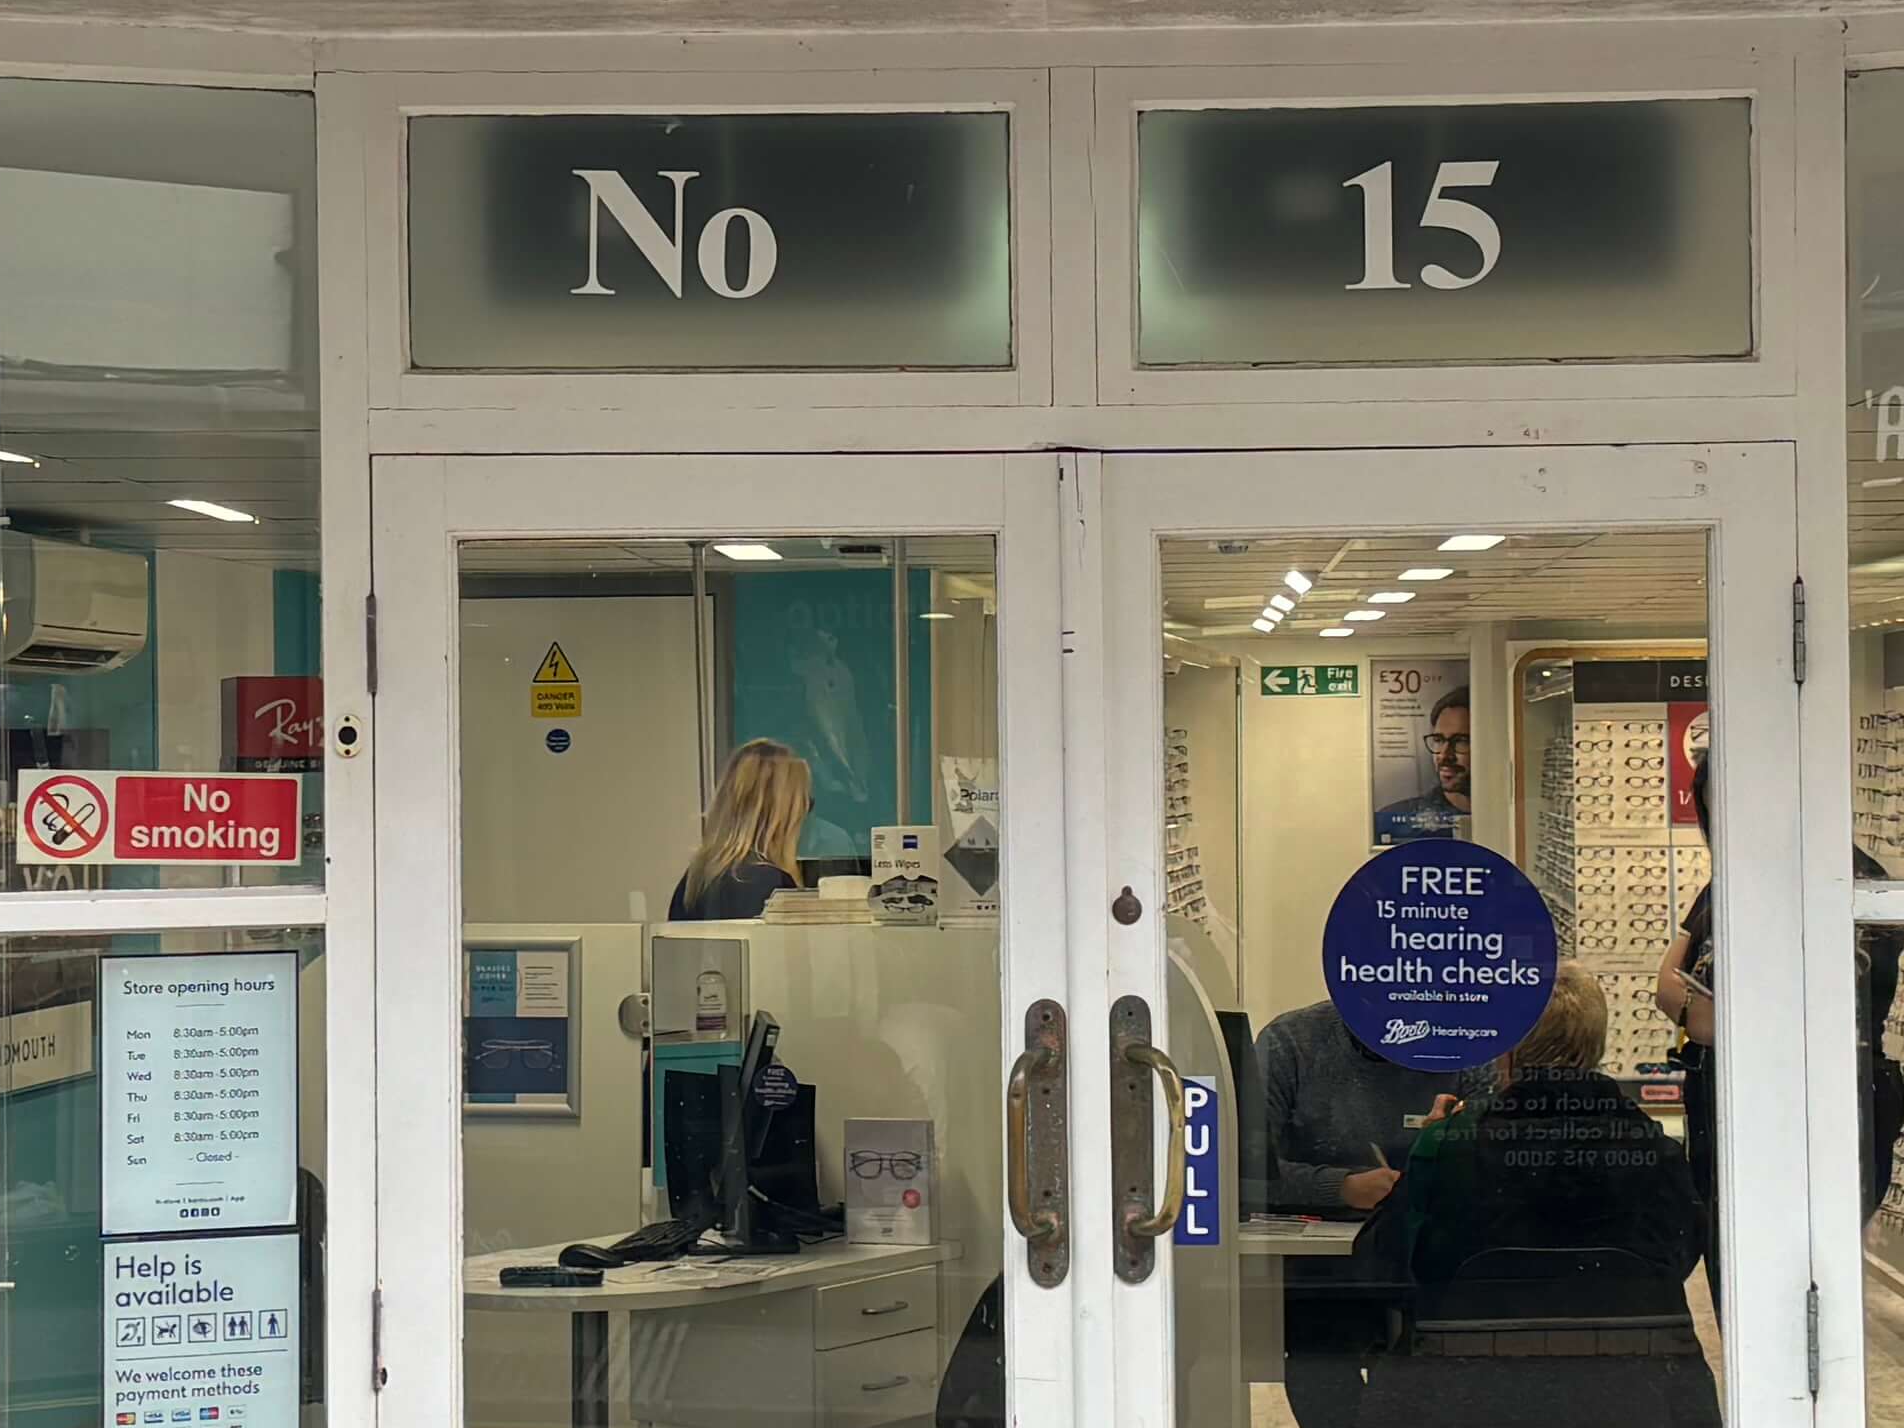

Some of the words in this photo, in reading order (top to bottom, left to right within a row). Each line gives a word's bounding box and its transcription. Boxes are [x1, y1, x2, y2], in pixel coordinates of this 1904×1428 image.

[571, 170, 778, 299] No
[1343, 161, 1501, 292] 15
[1327, 667, 1353, 679] Fire
[1380, 670, 1421, 694] £30
[1670, 675, 1707, 688] DES
[1328, 681, 1353, 692] exit
[183, 783, 231, 813] No
[960, 788, 999, 802] Polar
[130, 821, 280, 857] smoking
[874, 859, 892, 869] Lens
[895, 859, 921, 871] Wipes
[1377, 900, 1396, 919] 15
[1401, 901, 1469, 919] minute
[1390, 923, 1504, 960] hearing
[1340, 955, 1433, 983] health
[1442, 957, 1540, 985] checks
[123, 979, 163, 996] Store
[167, 978, 230, 997] opening
[234, 977, 275, 993] hours
[1388, 989, 1444, 1002] available
[1445, 990, 1457, 1002] in
[1459, 992, 1489, 1003] store
[127, 1028, 151, 1040] Mon
[1380, 1018, 1430, 1045] Boots
[1432, 1026, 1498, 1039] Hearingcare
[127, 1050, 146, 1061] Tue
[127, 1071, 152, 1081] Wed
[127, 1092, 148, 1103] Thu
[127, 1113, 141, 1124] Fri
[127, 1134, 145, 1145] Sat
[127, 1155, 147, 1166] Sun
[195, 1150, 233, 1163] Closed
[1184, 1086, 1210, 1235] PULL
[115, 1254, 176, 1283] Help
[185, 1253, 202, 1275] is
[115, 1280, 235, 1308] available
[115, 1369, 142, 1384] We
[146, 1367, 217, 1383] welcome
[220, 1363, 263, 1379] these
[115, 1386, 188, 1407] payment
[191, 1380, 261, 1398] methods
